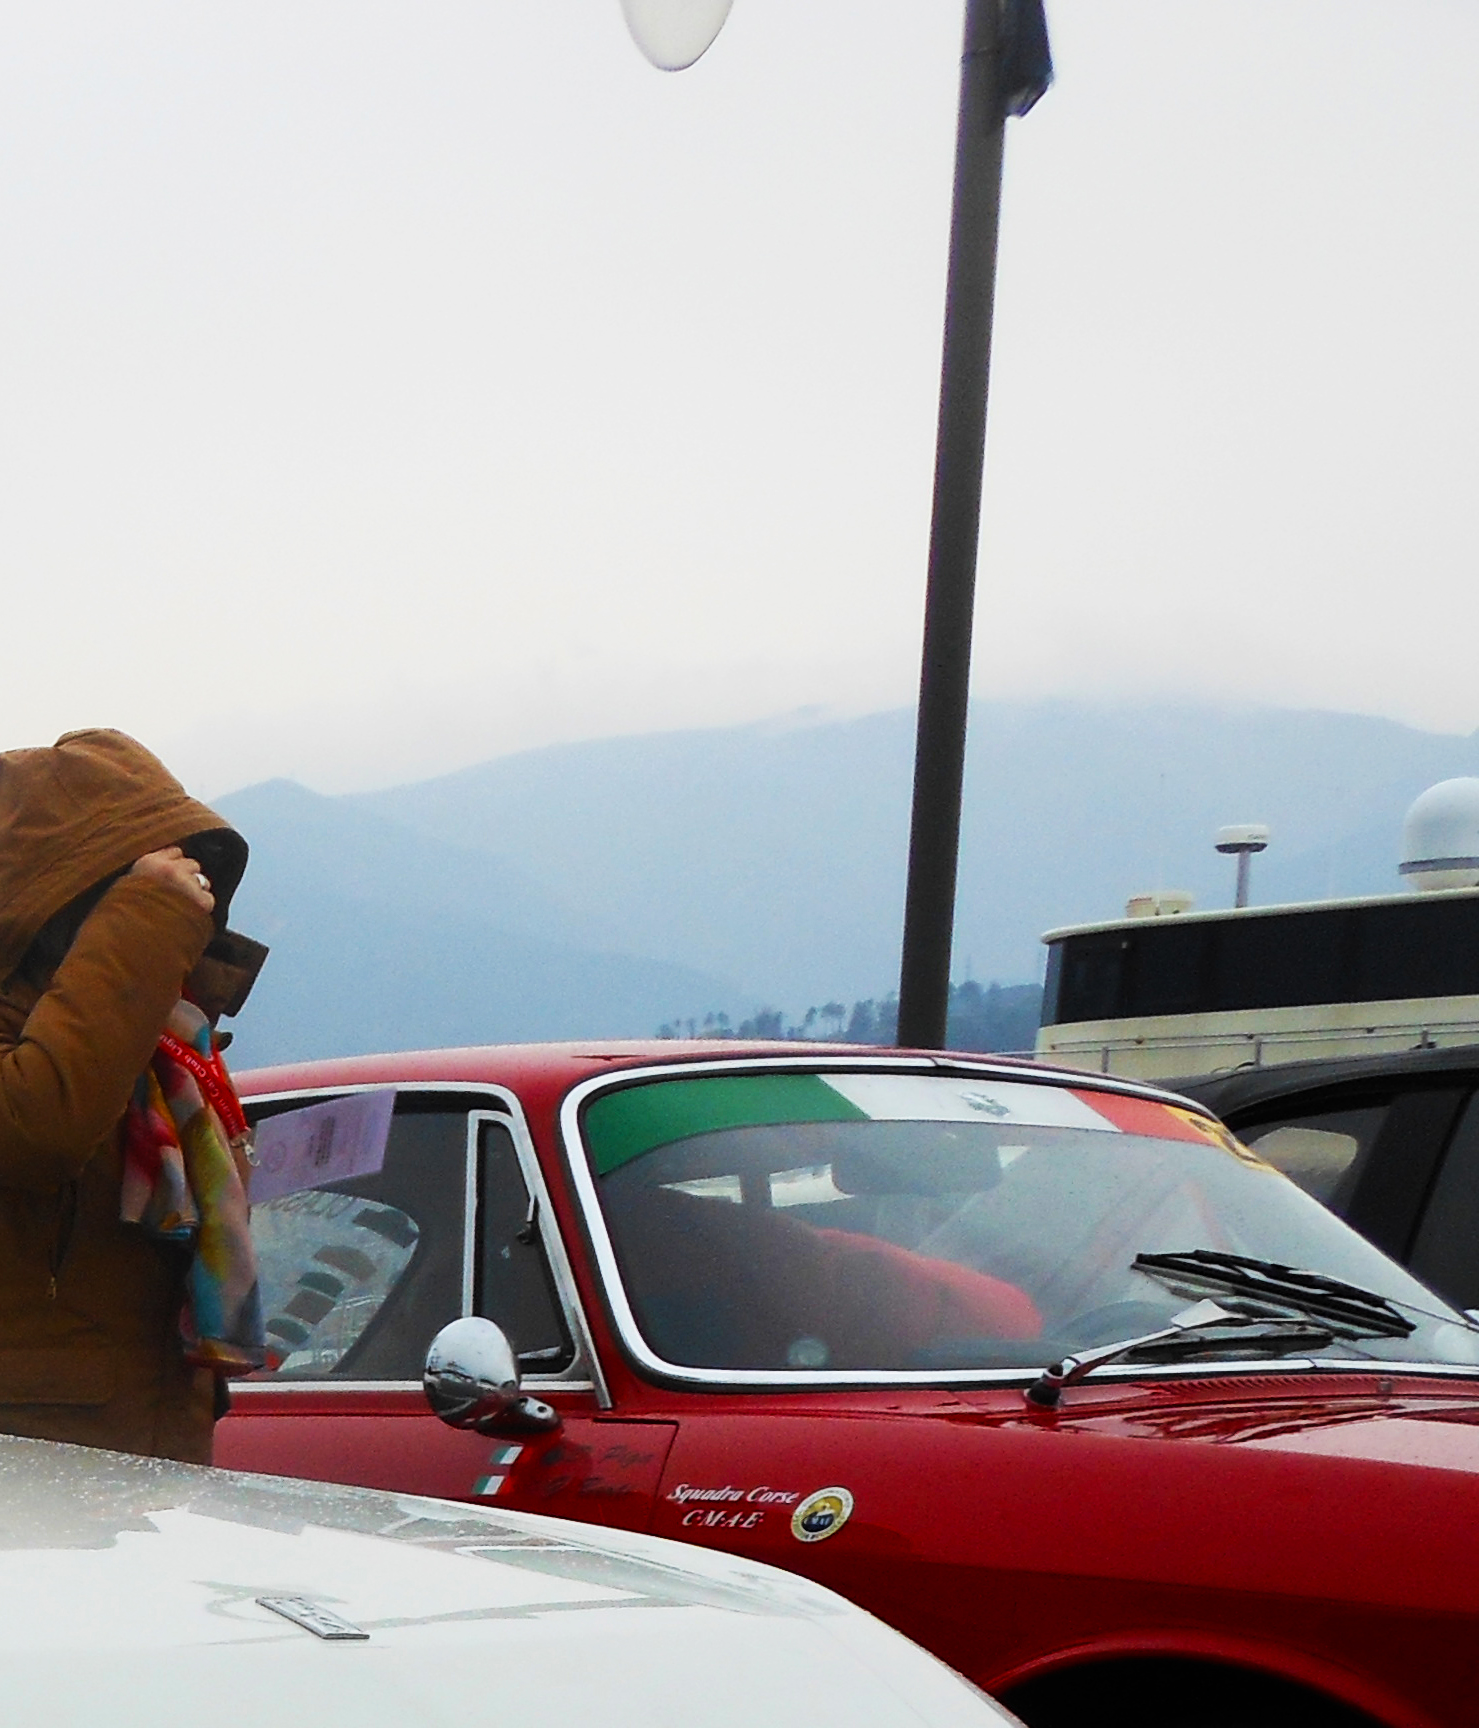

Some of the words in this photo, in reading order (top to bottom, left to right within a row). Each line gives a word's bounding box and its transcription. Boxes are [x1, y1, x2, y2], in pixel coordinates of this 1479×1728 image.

[184, 1054, 207, 1078] Club
[666, 1483, 746, 1506] Squadra
[746, 1486, 800, 1504] Corse
